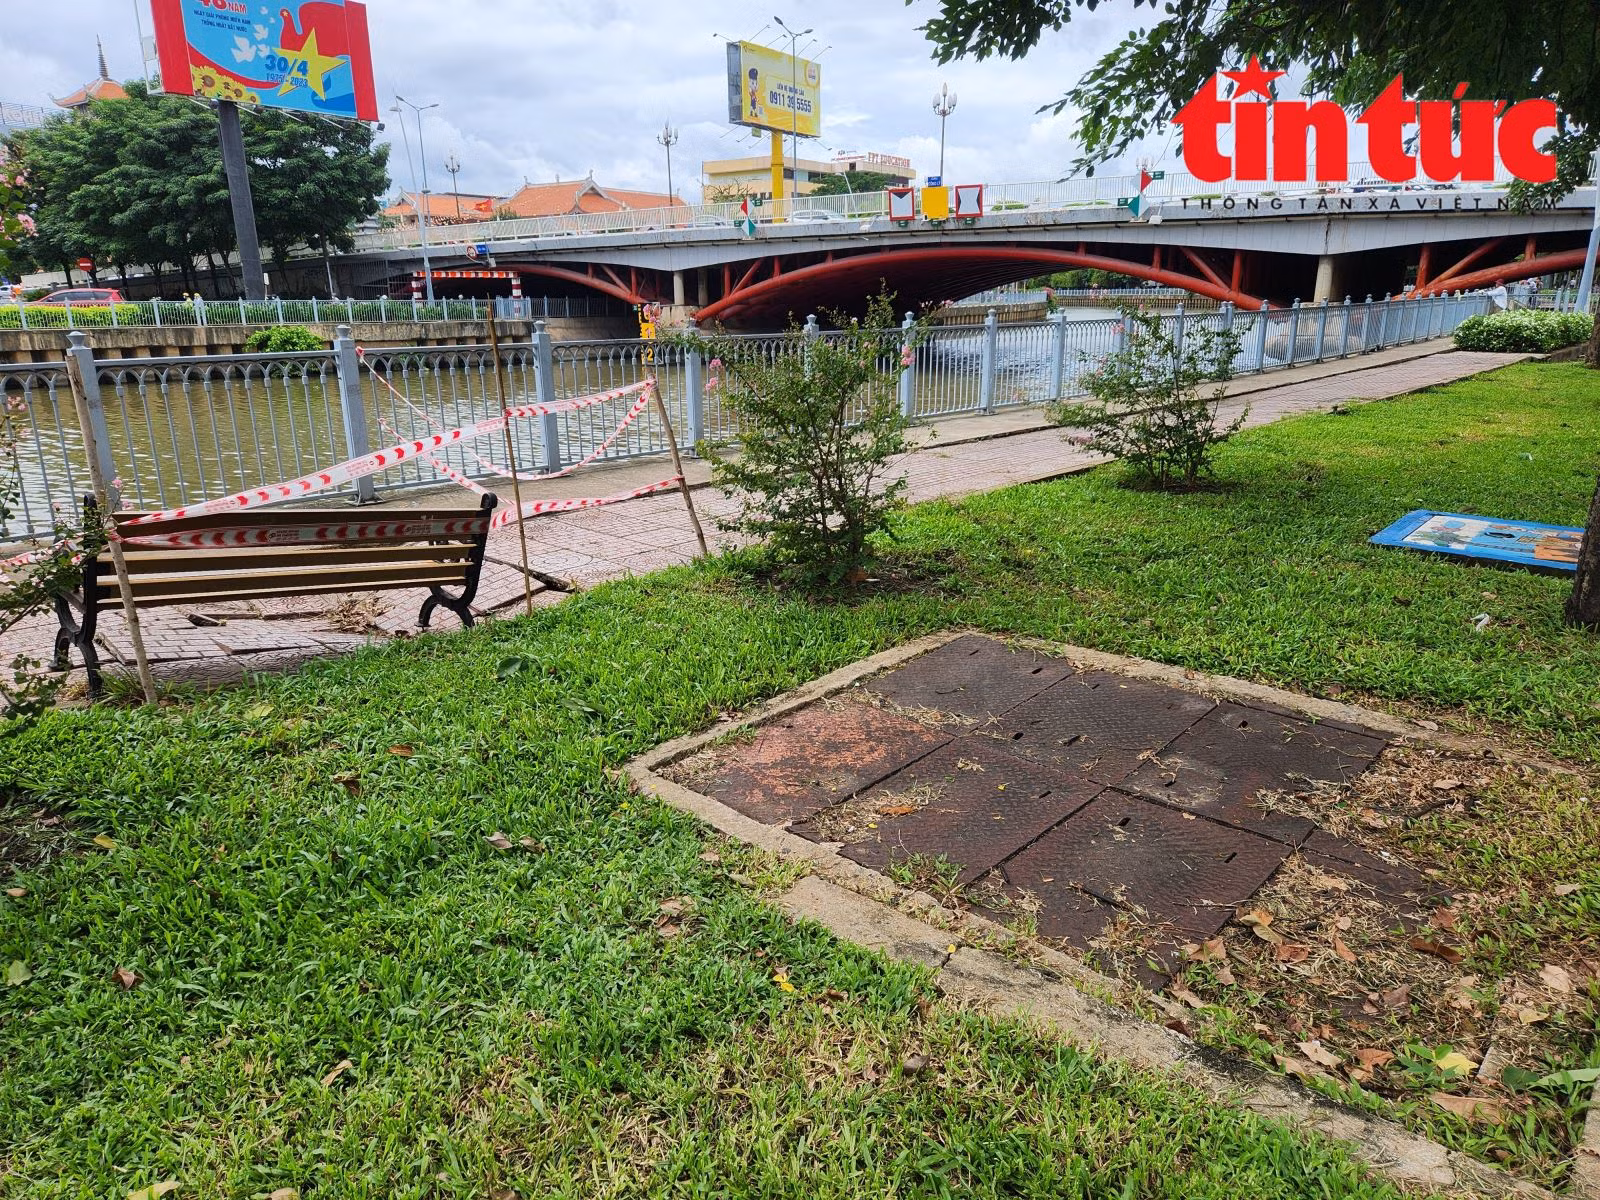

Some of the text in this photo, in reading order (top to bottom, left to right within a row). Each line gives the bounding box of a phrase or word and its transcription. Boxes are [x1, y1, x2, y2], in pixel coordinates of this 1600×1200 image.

[265, 54, 308, 76] 30/4
[769, 90, 785, 106] 0911
[796, 97, 812, 113] 5555
